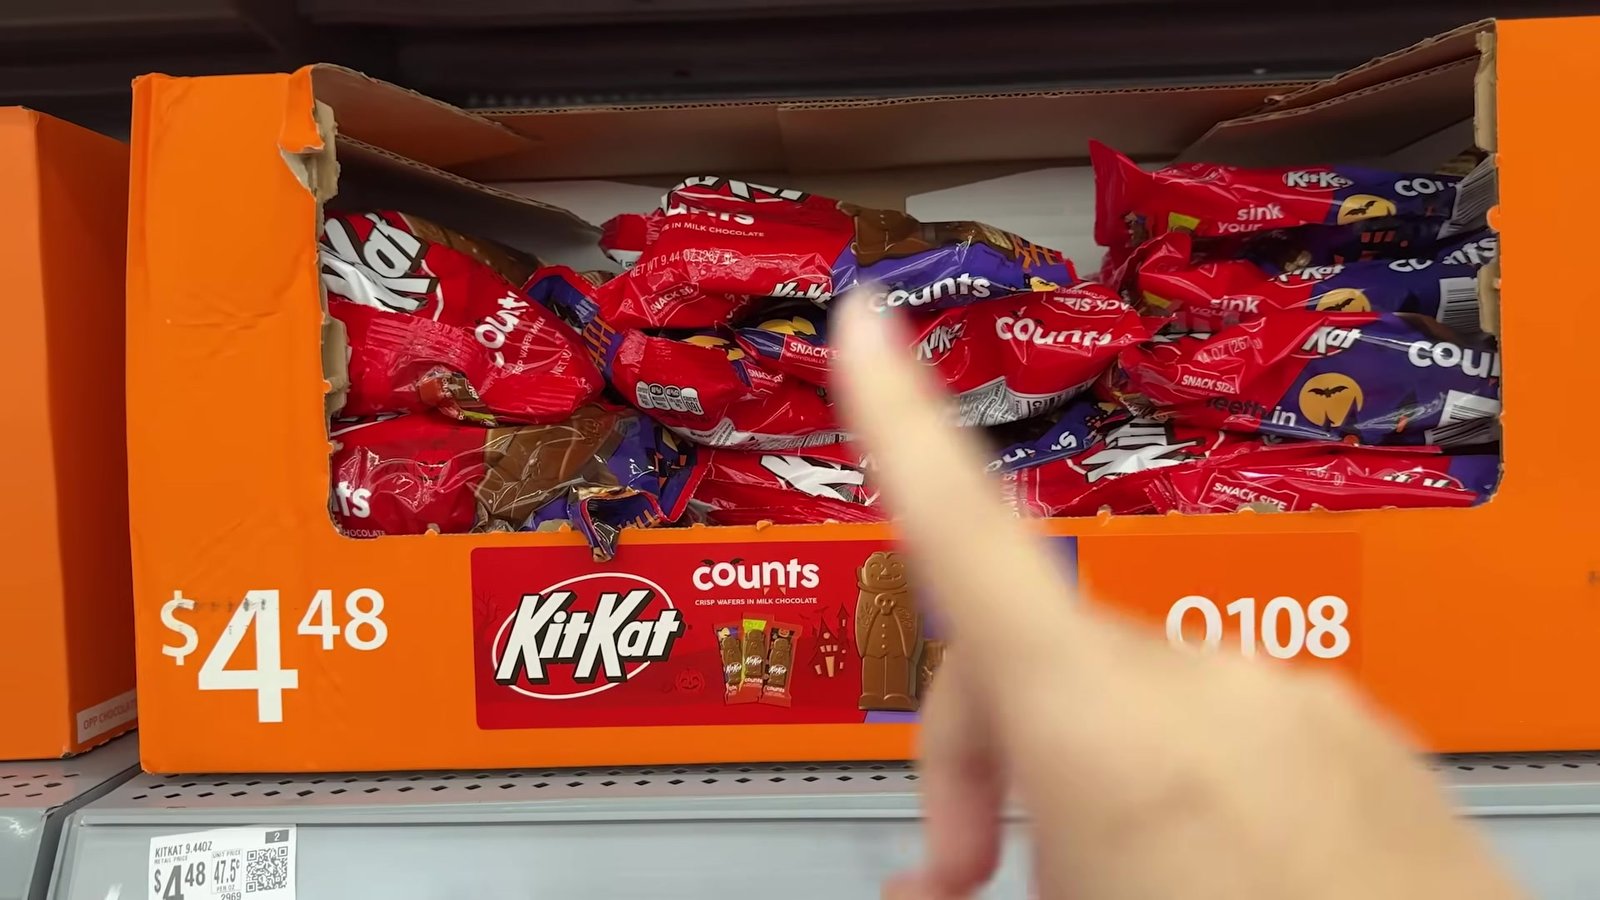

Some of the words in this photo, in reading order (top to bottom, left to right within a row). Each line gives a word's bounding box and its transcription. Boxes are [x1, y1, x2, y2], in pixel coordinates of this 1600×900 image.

[1287, 171, 1354, 187] KitKat
[1236, 203, 1285, 221] sink
[683, 222, 707, 232] MILK
[708, 226, 765, 237] CHOCOLATE
[1217, 221, 1263, 234] your
[1210, 295, 1261, 314] sink
[996, 316, 1114, 347] counts
[789, 341, 829, 359] SNACK
[1181, 374, 1214, 390] SNACK
[1271, 405, 1297, 428] in
[1212, 481, 1259, 503] SNACK
[691, 557, 820, 592] counts
[716, 598, 746, 606] WAFERS
[756, 597, 774, 605] MILK
[774, 596, 818, 605] CHOCOLATE
[495, 588, 687, 686] KitKat
[155, 844, 183, 858] KITKAT
